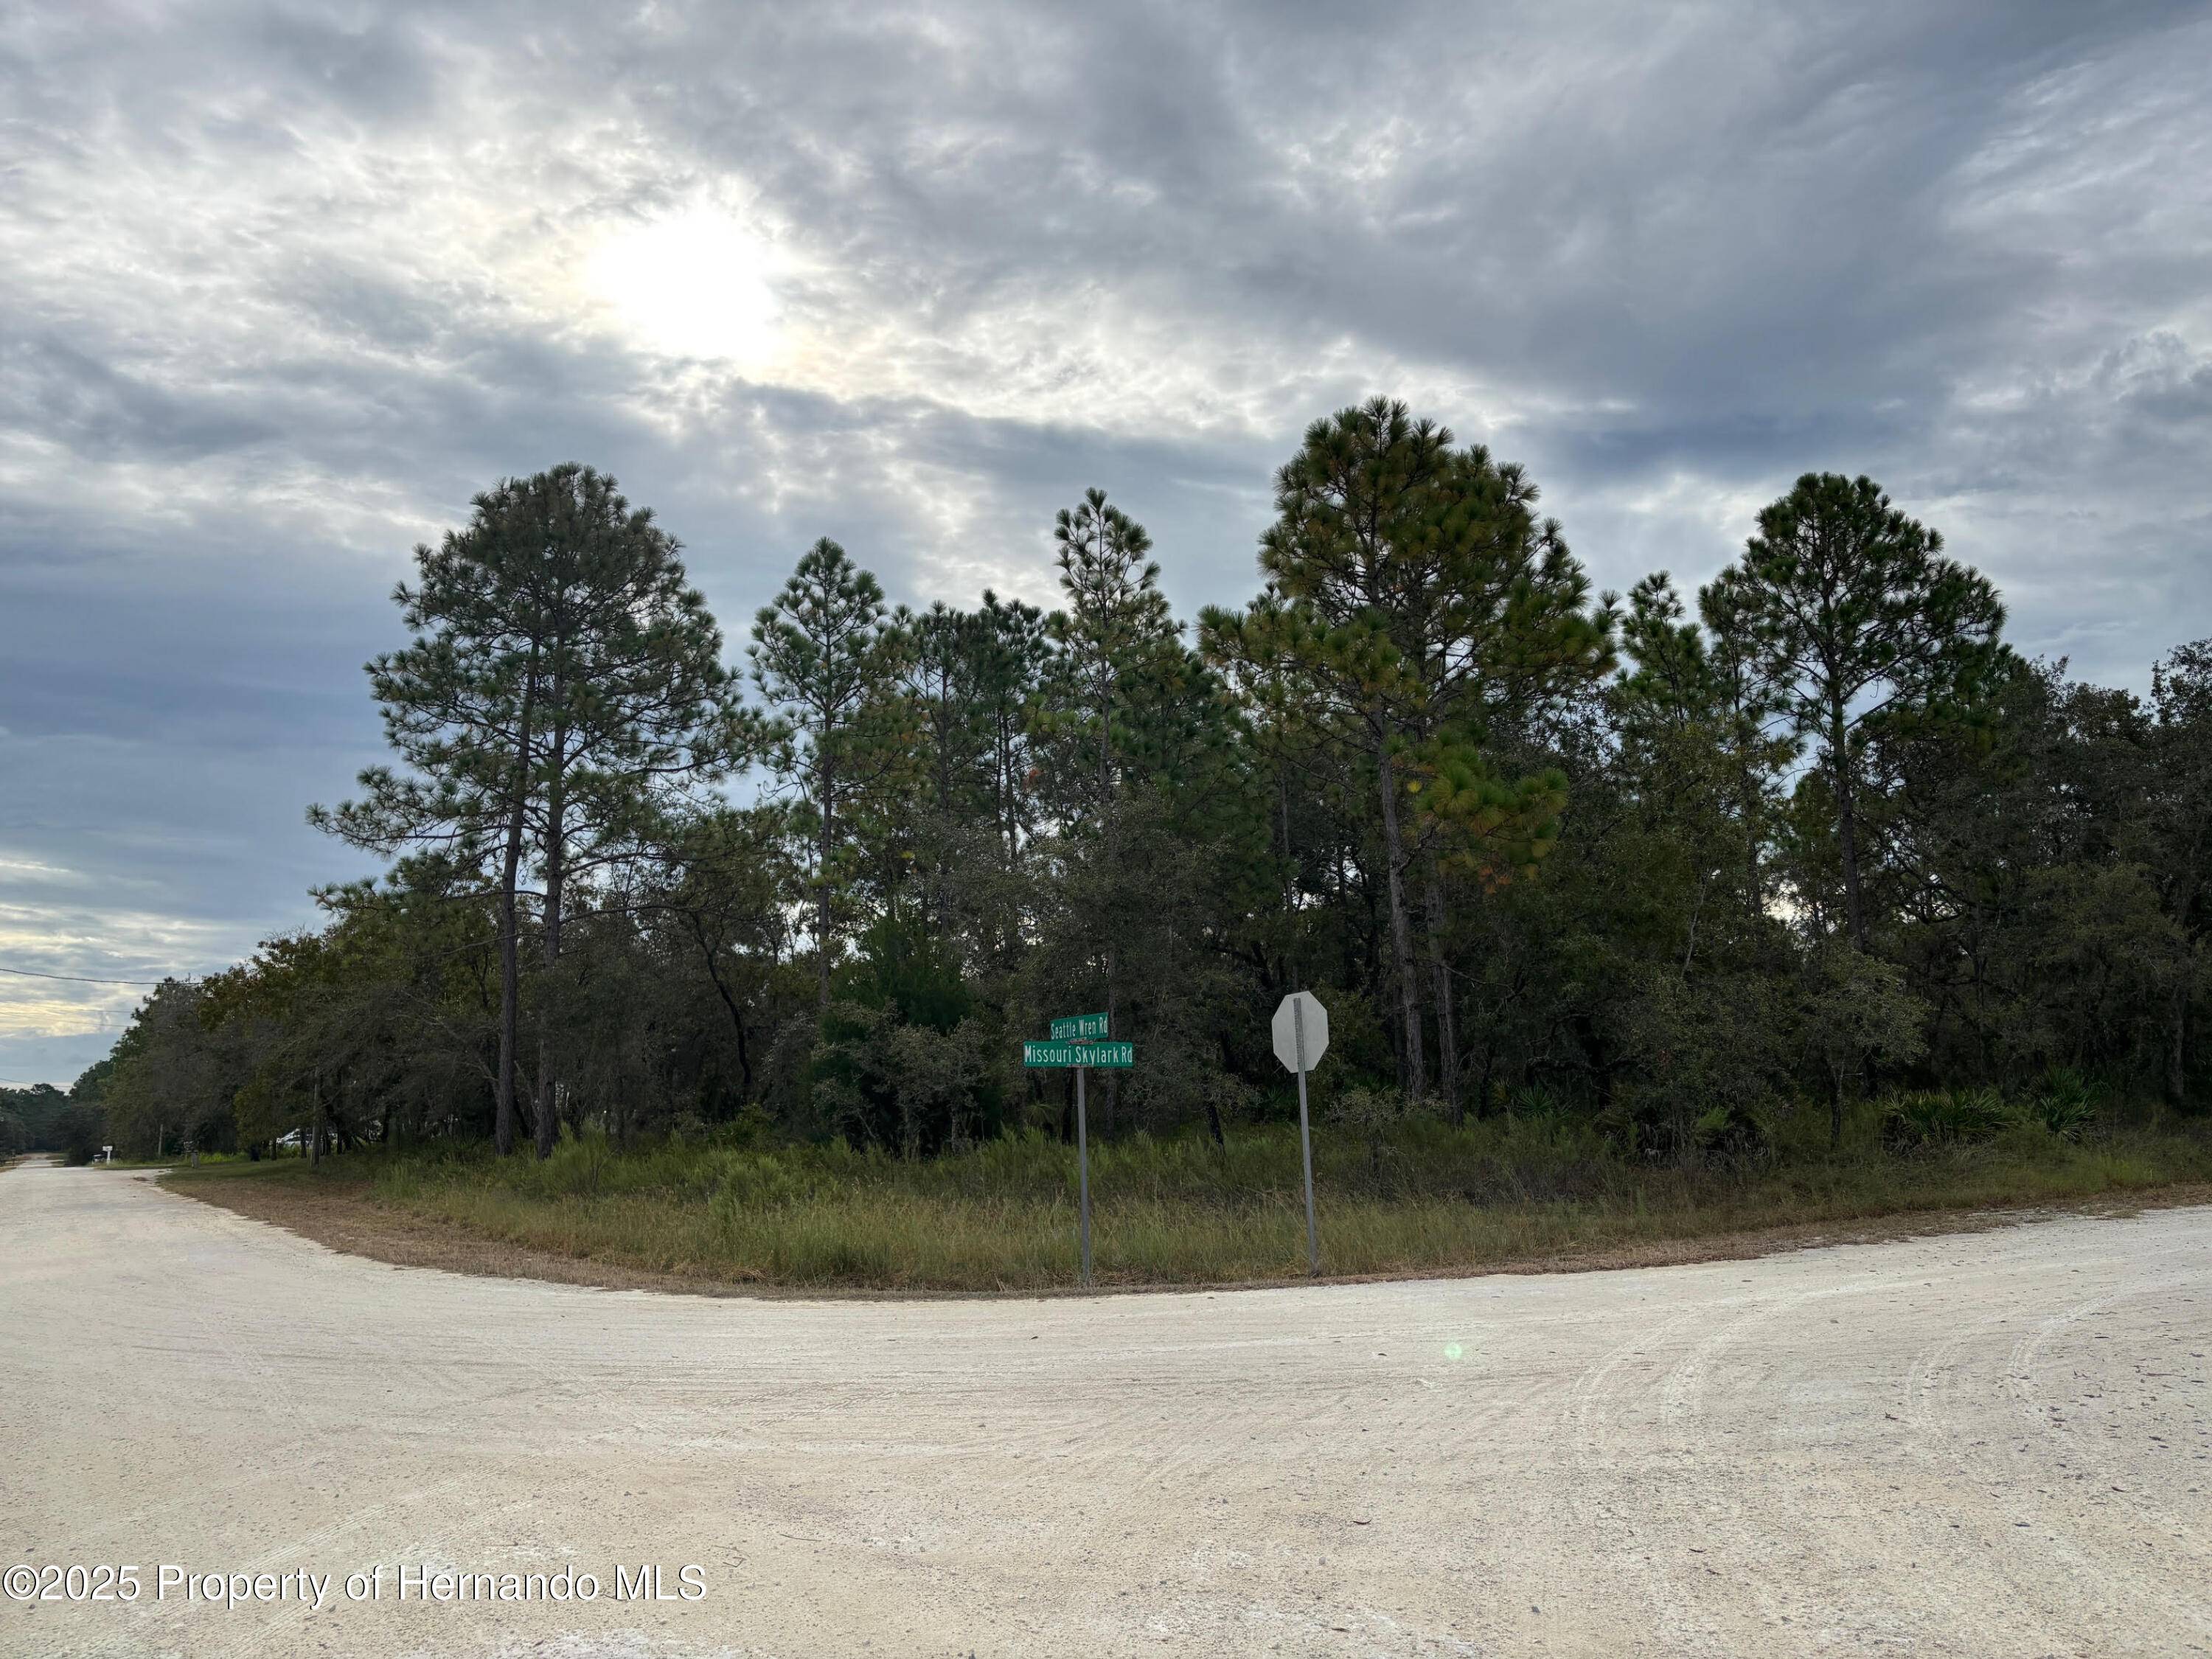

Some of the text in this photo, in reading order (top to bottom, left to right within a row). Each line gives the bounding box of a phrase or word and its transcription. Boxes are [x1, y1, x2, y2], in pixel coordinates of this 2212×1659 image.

[1051, 1017, 1107, 1040] Seattle Wren Rd
[1024, 1046, 1133, 1065] Missouri Skylark Rd
